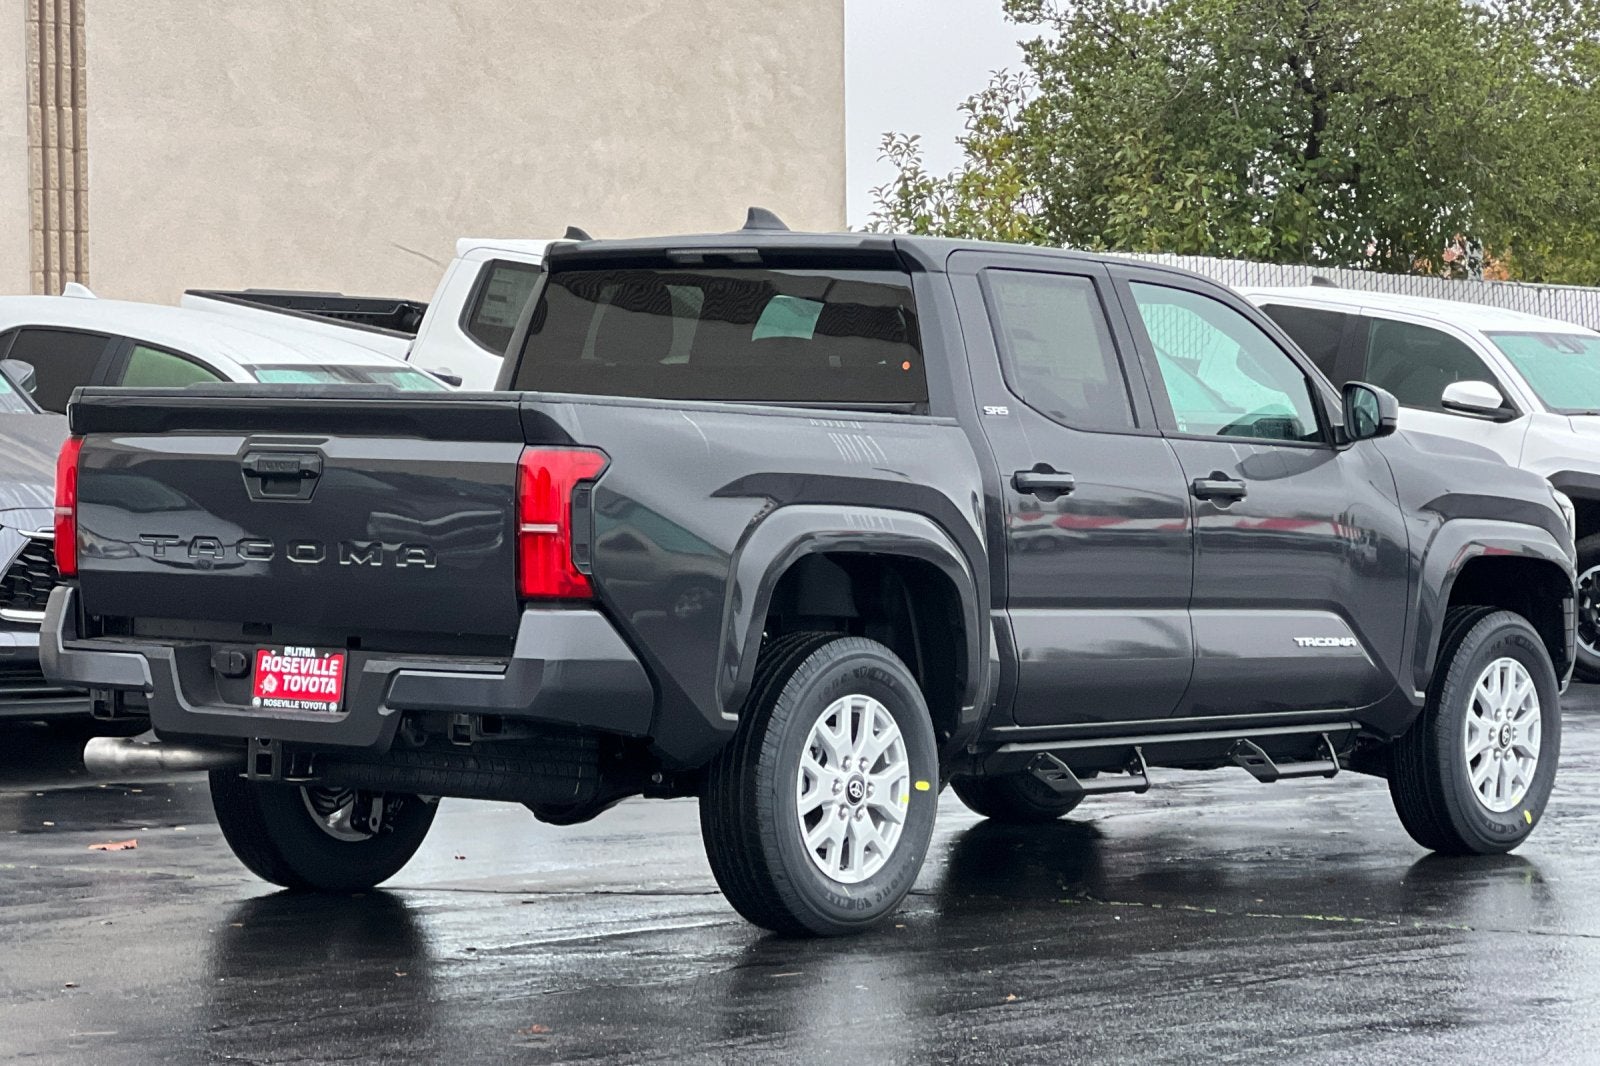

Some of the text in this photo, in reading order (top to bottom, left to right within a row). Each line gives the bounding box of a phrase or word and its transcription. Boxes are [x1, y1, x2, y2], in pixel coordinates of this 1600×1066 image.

[139, 533, 438, 568] TACOMA
[1293, 636, 1357, 647] TACOMA
[291, 647, 316, 658] LITHIA
[260, 655, 340, 676] ROSEVILLE
[282, 674, 337, 694] TOYOTA
[263, 698, 327, 711] ROSEVILLE TOYOTA
